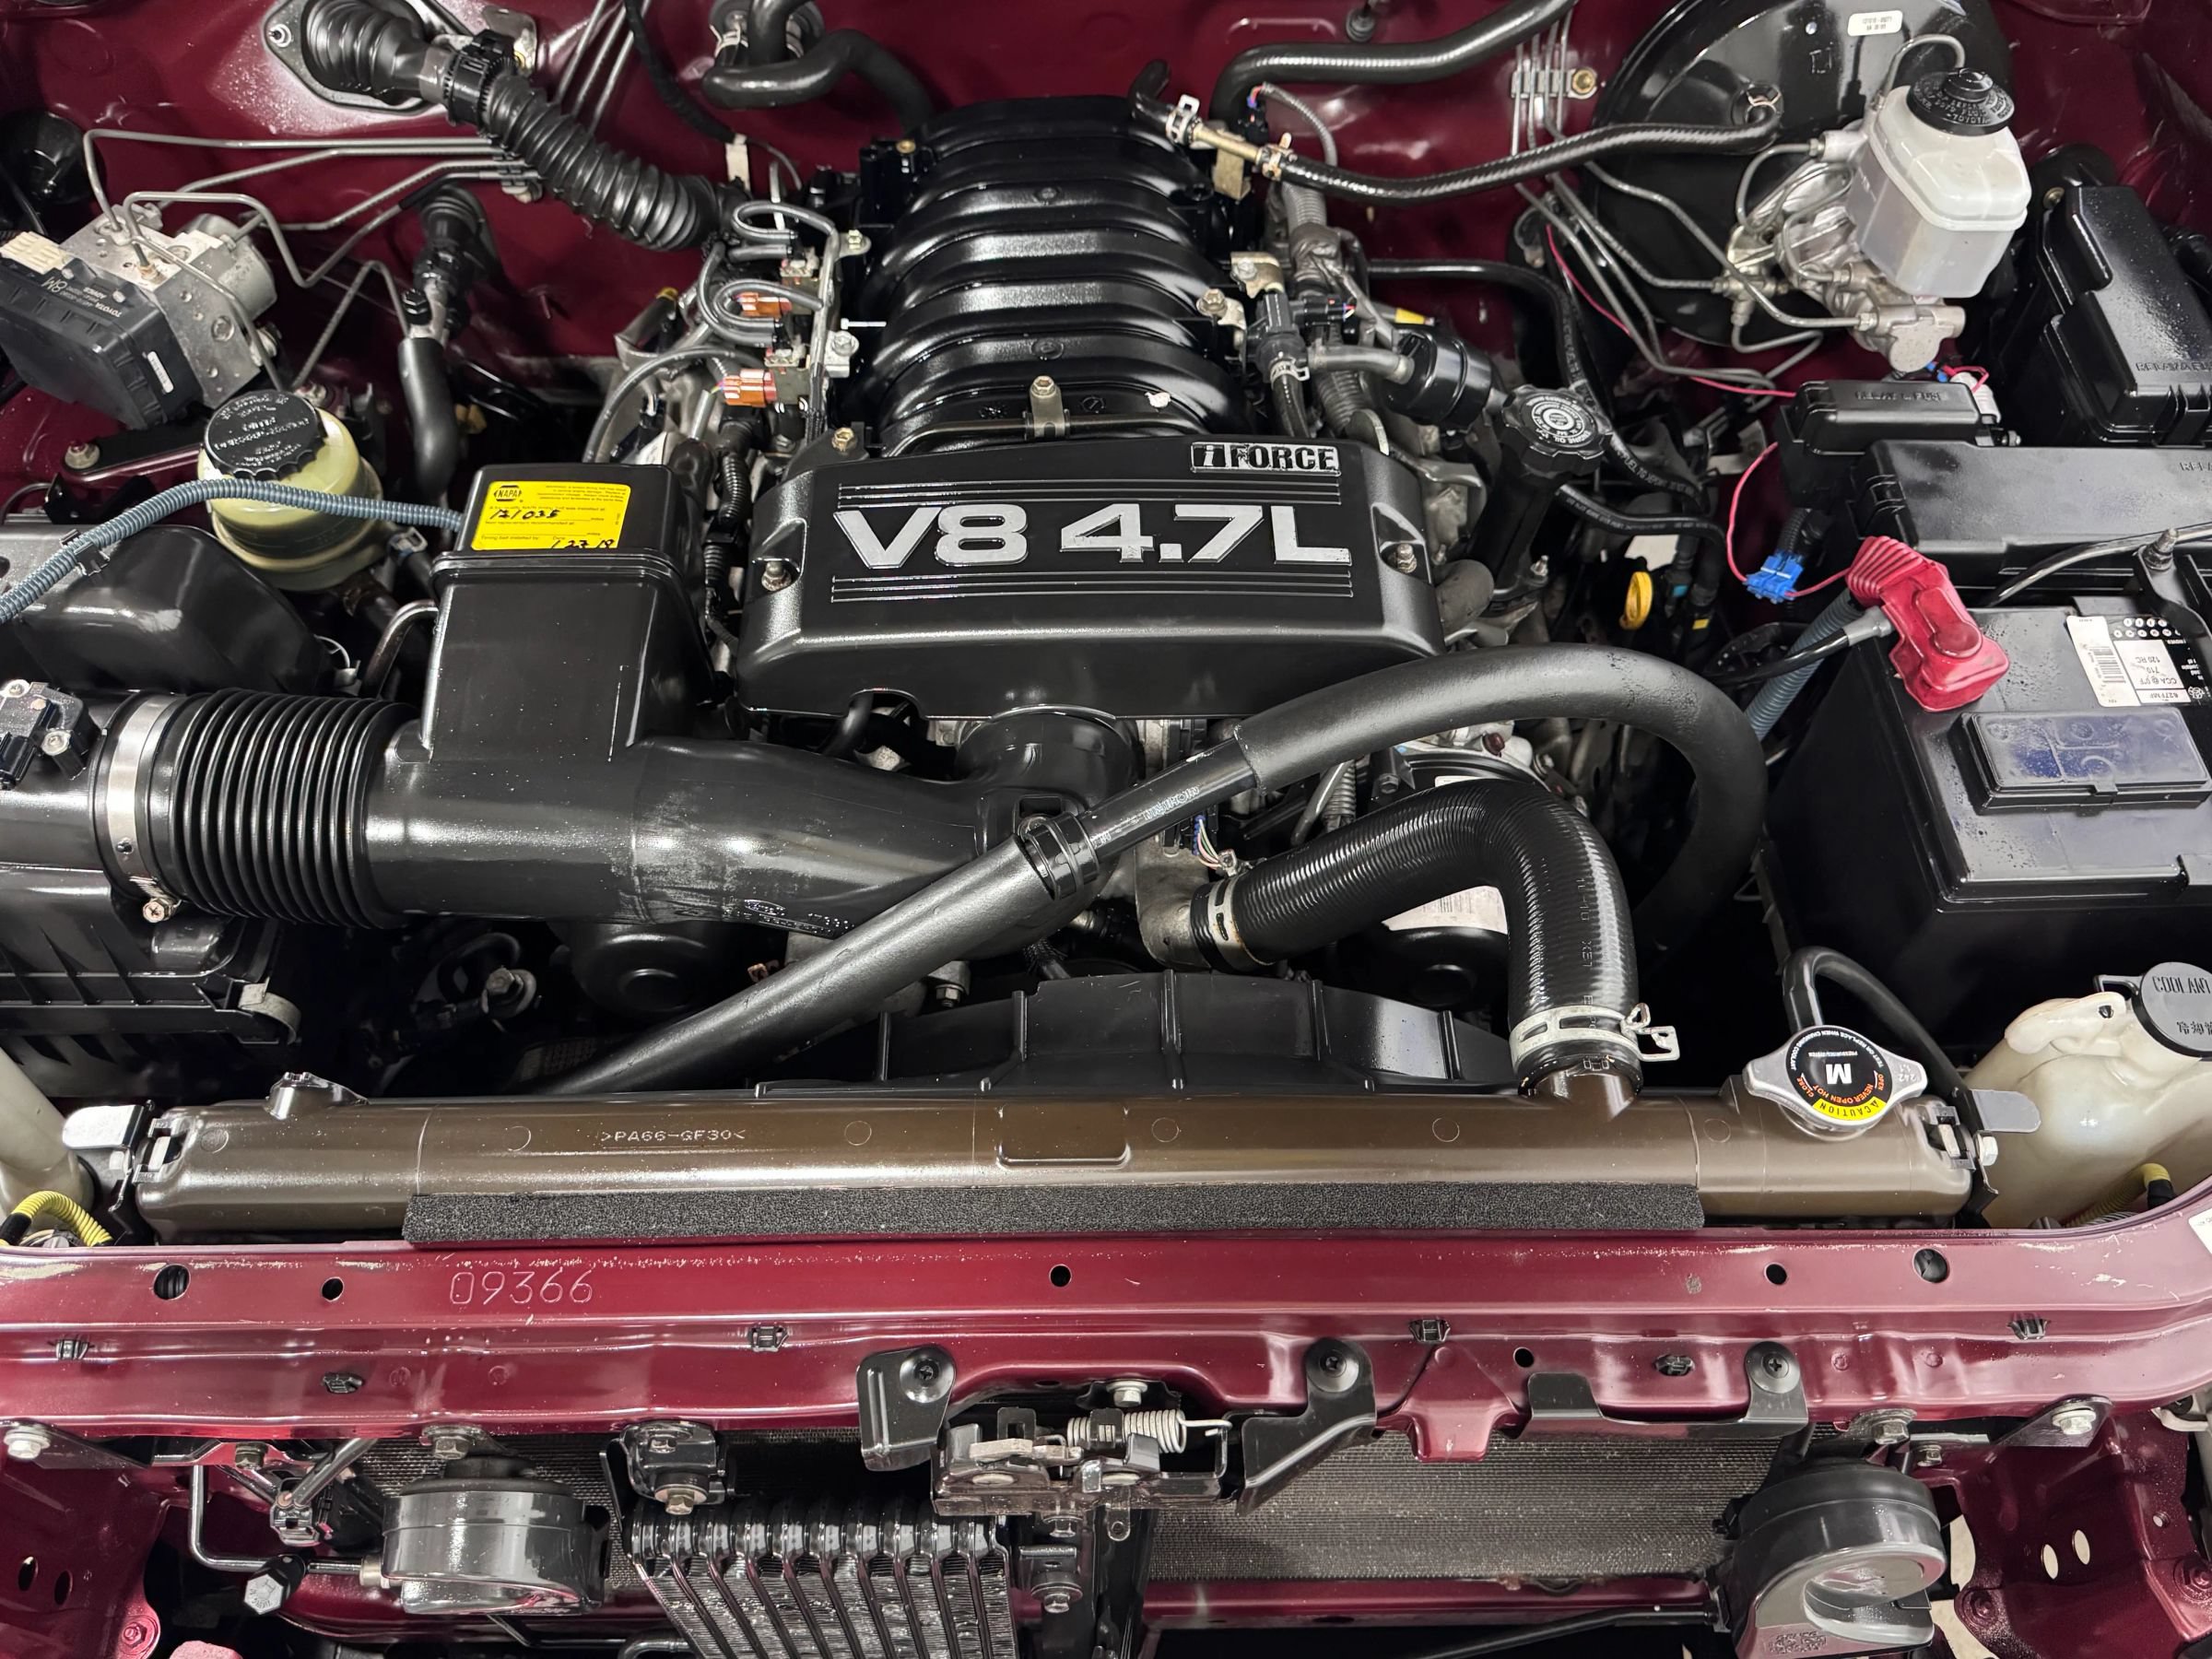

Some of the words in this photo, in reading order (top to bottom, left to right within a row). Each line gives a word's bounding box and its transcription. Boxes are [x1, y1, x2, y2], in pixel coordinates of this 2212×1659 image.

[41, 276, 68, 293] 8M
[95, 302, 123, 318] TOYOTA
[1230, 444, 1336, 471] FORCE
[494, 487, 522, 500] NAPA
[833, 503, 1027, 570] V8
[1059, 503, 1352, 566] 4.7L
[1790, 1046, 1800, 1071] COOLANT
[1840, 1031, 1868, 1048] REPLACE
[1872, 1053, 1884, 1068] TEST
[1825, 1064, 1853, 1085] M
[1796, 1077, 1814, 1098] CLOSE
[1813, 1083, 1830, 1099] HOT
[1855, 1083, 1875, 1104] NEVER
[1819, 1101, 1872, 1117] CAUTION
[1830, 1094, 1853, 1104] OPEN
[450, 1266, 593, 1305] 09366
